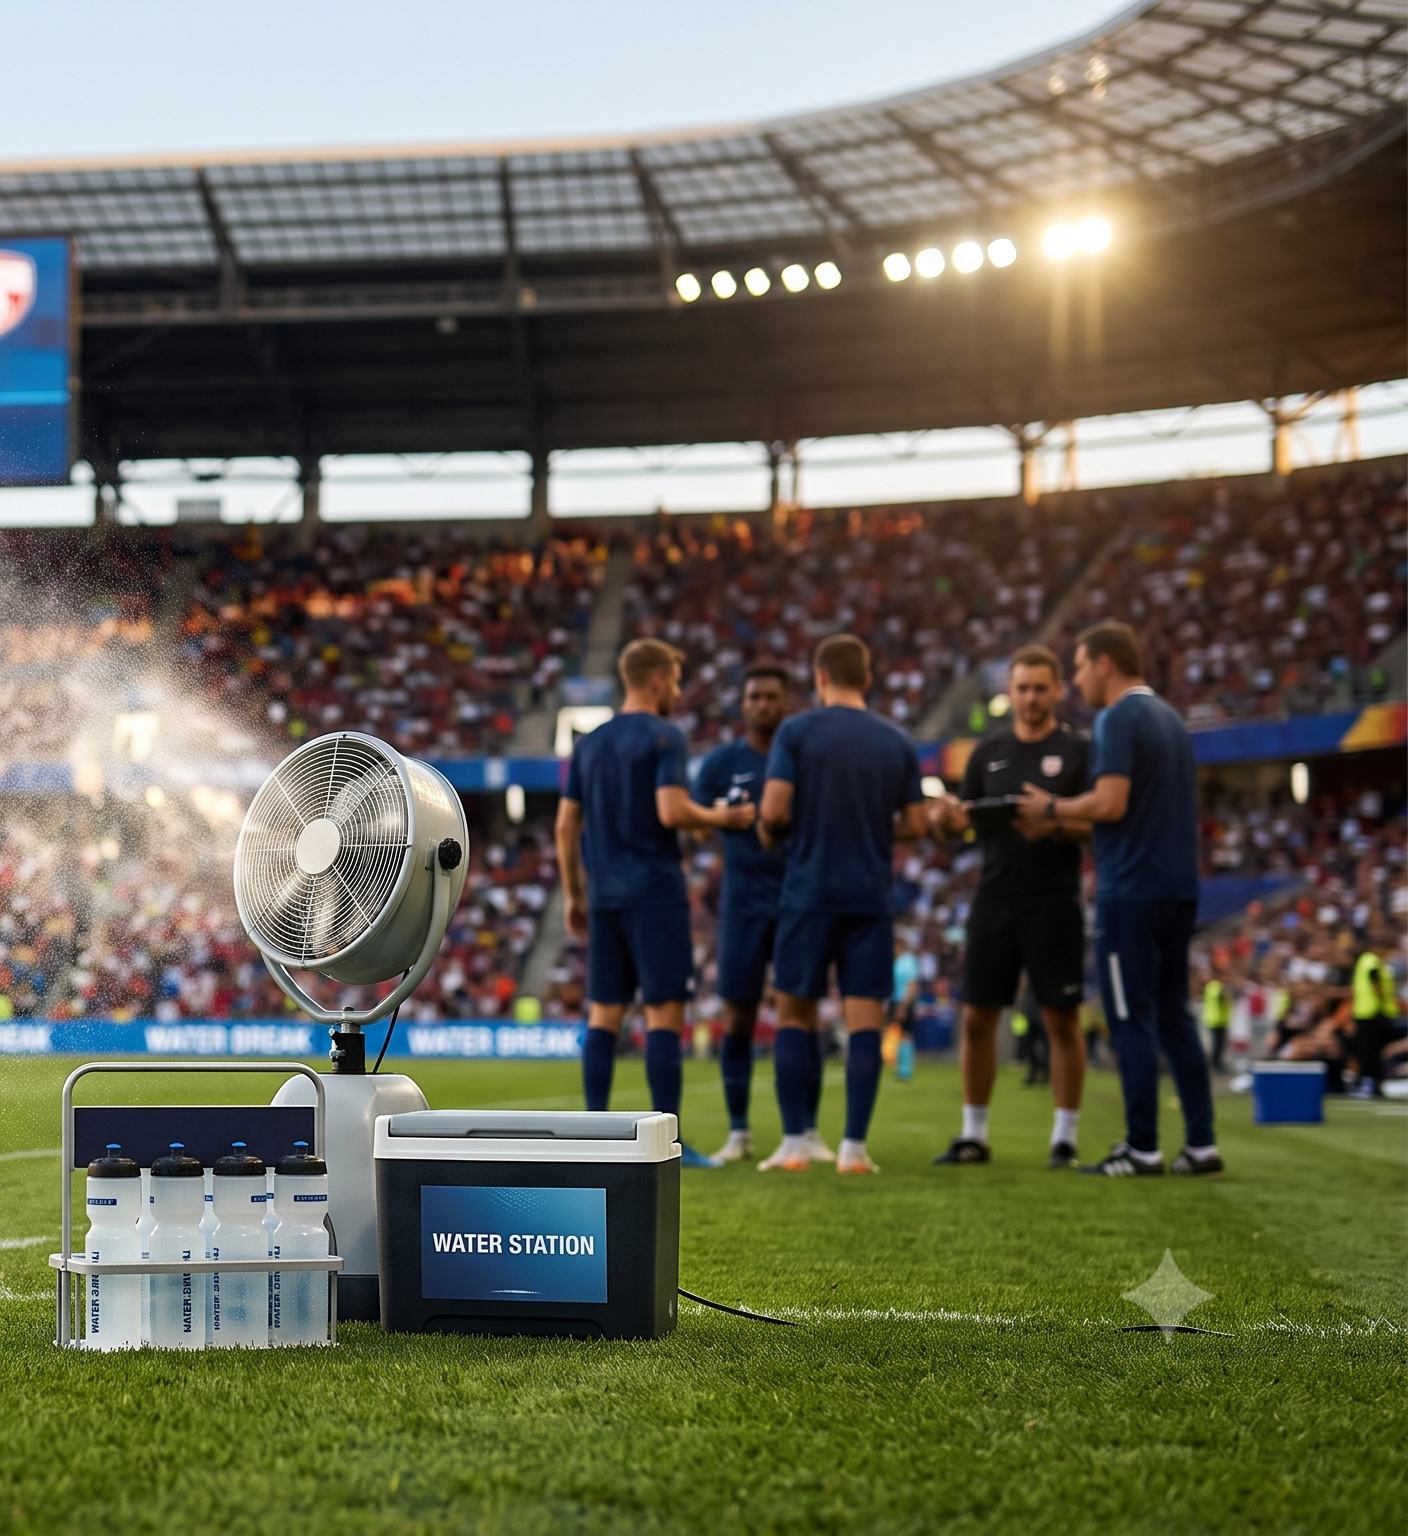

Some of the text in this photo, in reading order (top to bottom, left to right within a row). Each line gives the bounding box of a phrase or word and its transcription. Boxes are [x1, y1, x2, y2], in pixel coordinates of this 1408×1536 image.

[144, 1025, 313, 1054] WATER BREAK
[407, 1026, 581, 1057] WATER BREAK
[433, 1232, 595, 1256] WATER STATION
[92, 1299, 100, 1333] WATER
